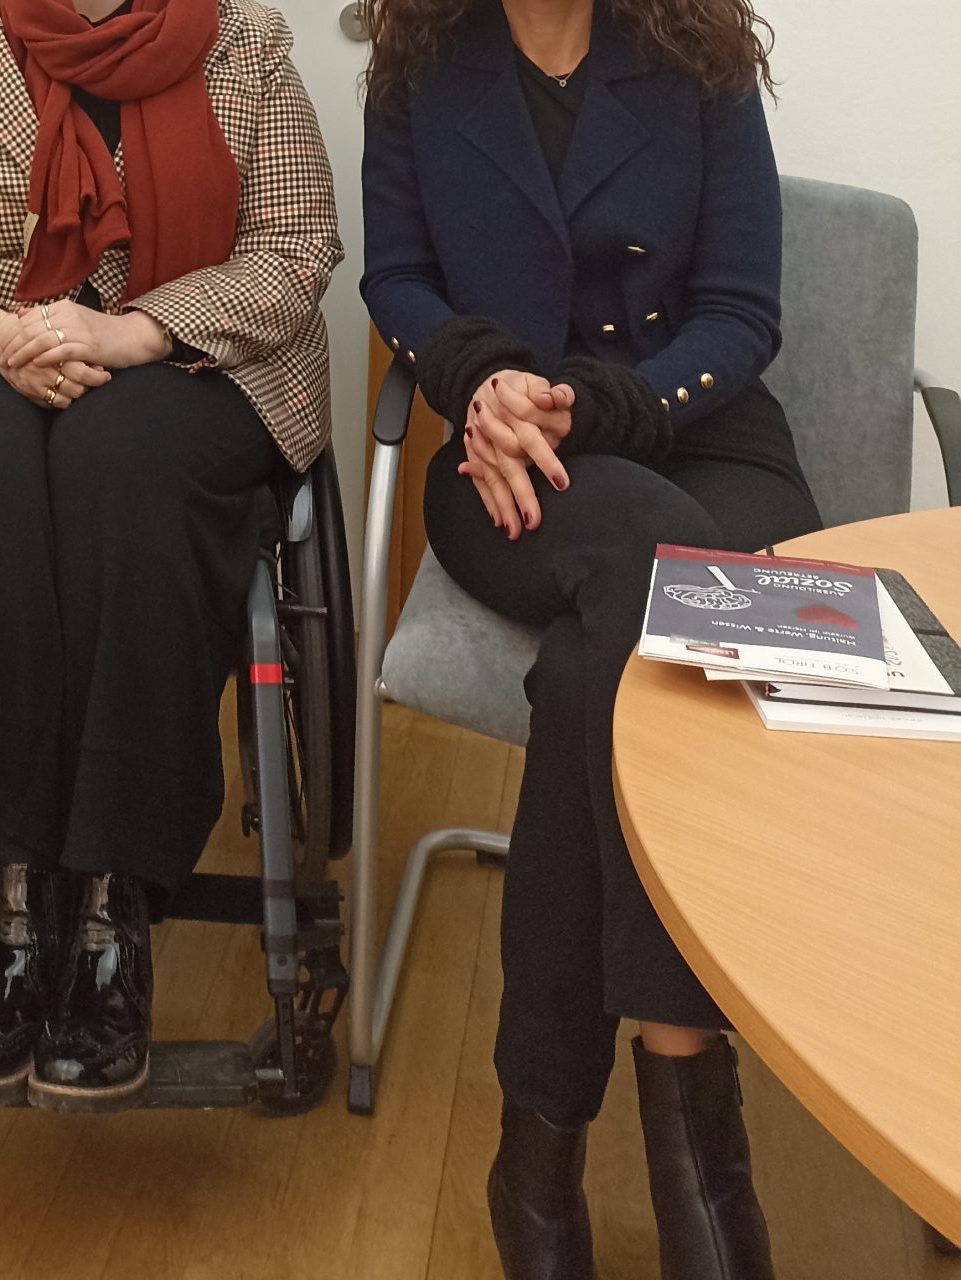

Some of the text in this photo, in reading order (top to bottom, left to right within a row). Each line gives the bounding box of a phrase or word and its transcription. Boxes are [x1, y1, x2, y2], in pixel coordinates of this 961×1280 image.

[753, 567, 820, 580] BETREUUNG
[754, 574, 854, 593] Sozial
[773, 583, 845, 597] AUSBILDUNG
[711, 620, 752, 631] Wissen
[767, 627, 804, 638] Werte
[806, 632, 856, 647] Haltung,
